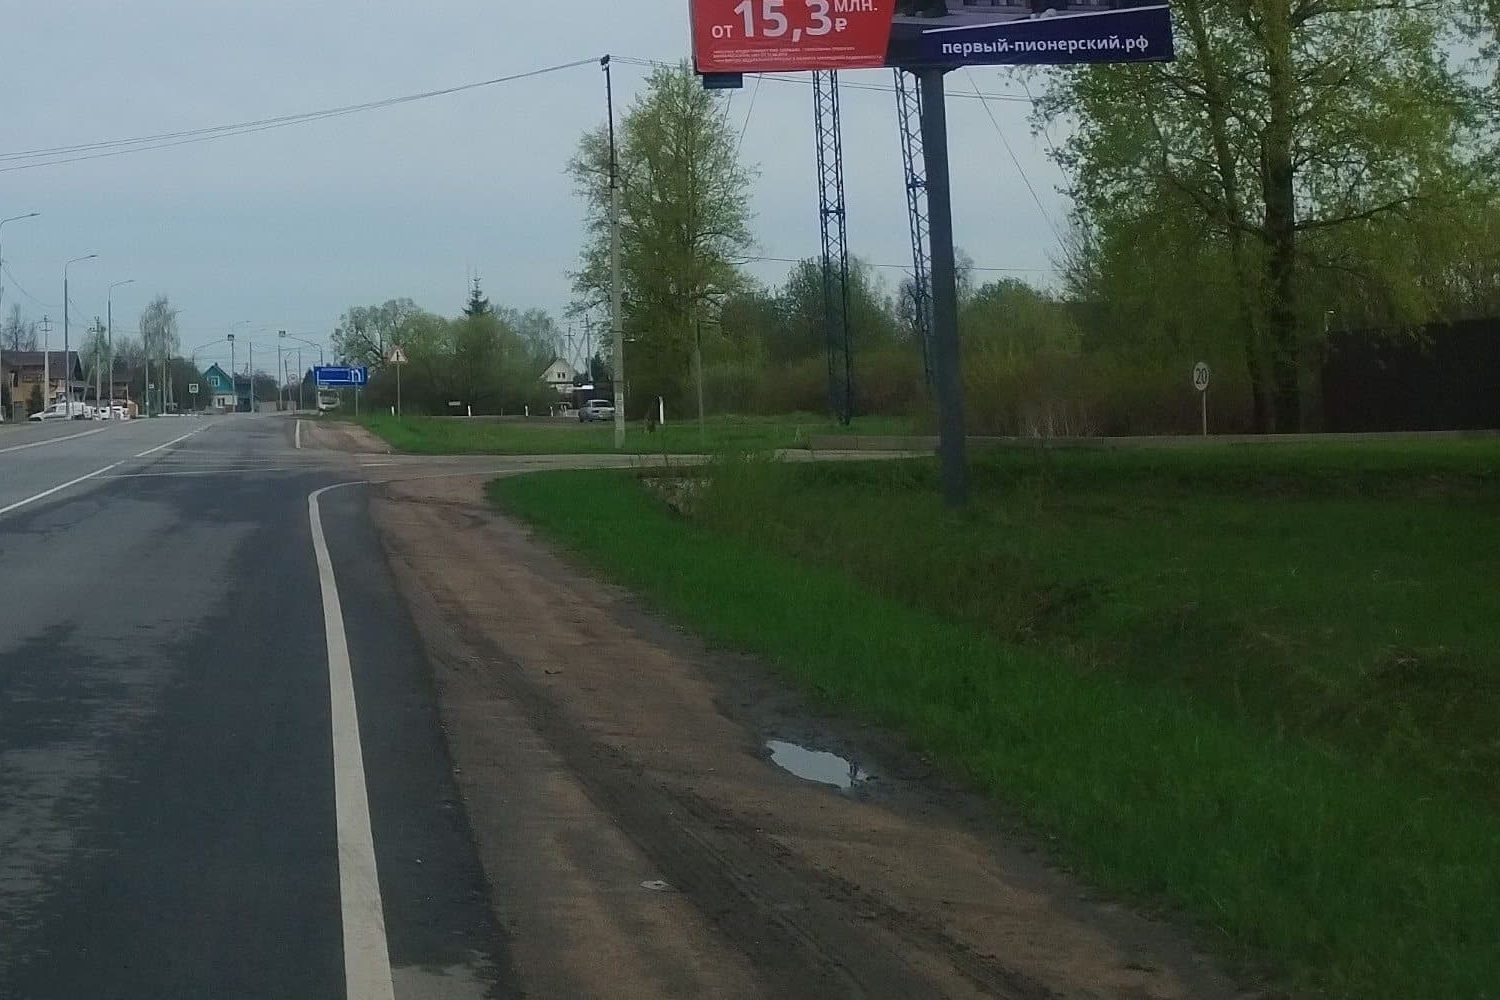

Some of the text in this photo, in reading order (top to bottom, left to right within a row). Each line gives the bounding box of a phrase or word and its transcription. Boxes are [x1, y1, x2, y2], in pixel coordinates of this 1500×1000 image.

[834, 0, 878, 13] МЛН.
[942, 35, 1149, 57] первый-пионерский.рф
[1195, 367, 1208, 385] 20
